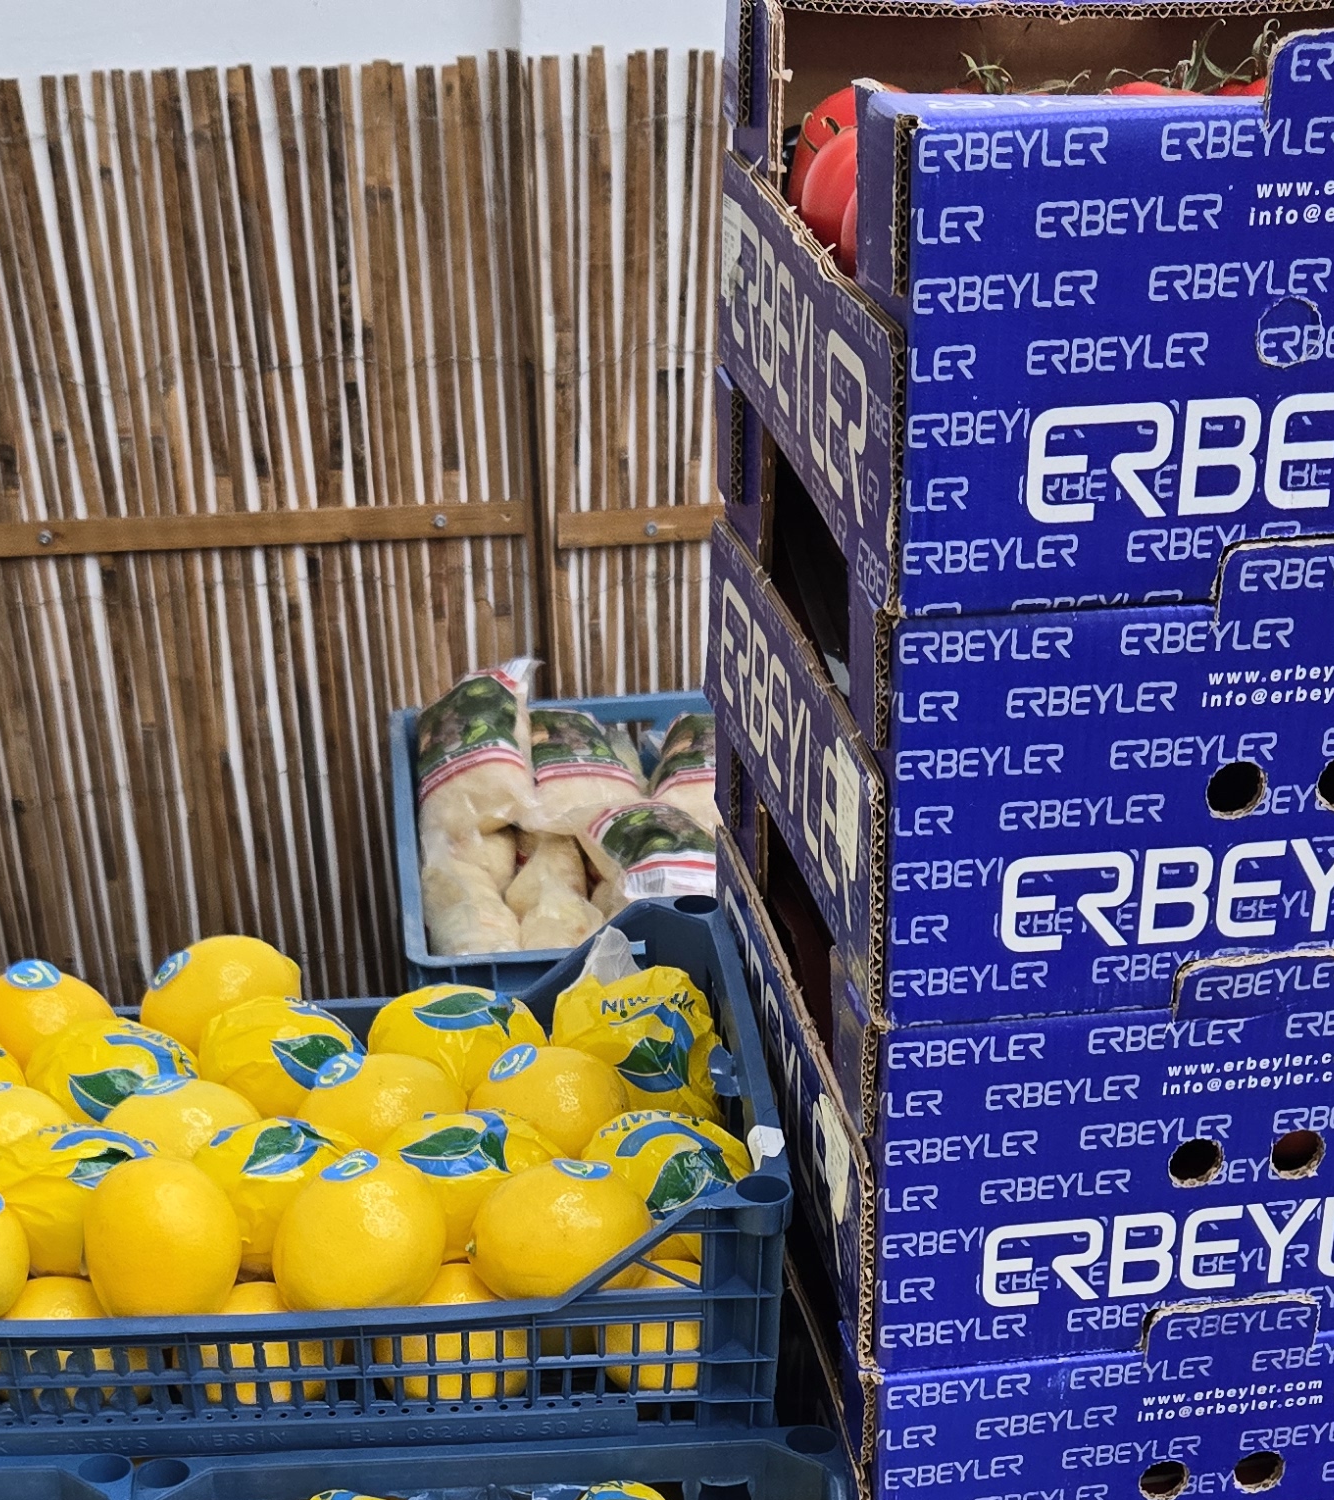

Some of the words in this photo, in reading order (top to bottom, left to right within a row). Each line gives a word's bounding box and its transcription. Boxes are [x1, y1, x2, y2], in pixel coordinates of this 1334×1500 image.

[919, 127, 1109, 173] ERBEYLER
[1036, 195, 1222, 238] ERBEYLER
[913, 269, 1098, 315] ERBEYLER
[1149, 257, 1332, 301] ERBEYLER
[1027, 332, 1208, 375] ERBEYLER
[902, 534, 1078, 575] ERBEYLER
[899, 627, 1073, 664] ERBEYLER
[1120, 618, 1294, 656] ERBEYLER
[1006, 681, 1177, 719] ERBEYLER
[895, 744, 1064, 781] ERBEYLER
[999, 794, 1165, 831] ERBEYLER
[889, 961, 1048, 997] ERBEYLER
[888, 1033, 1045, 1069] ERBEYLER
[1089, 1019, 1245, 1054] ERBEYLER
[985, 1074, 1140, 1111] ERBEYLER
[880, 1130, 1038, 1166] ERBEYLER
[980, 1169, 1131, 1204] ERBEYLER
[1167, 1306, 1311, 1341] ERBEYLER
[1137, 1394, 1323, 1422] info@erbeyler.com
[1142, 1379, 1322, 1407] www.erbeyler.com
[976, 1405, 1117, 1440] ERBEYLER
